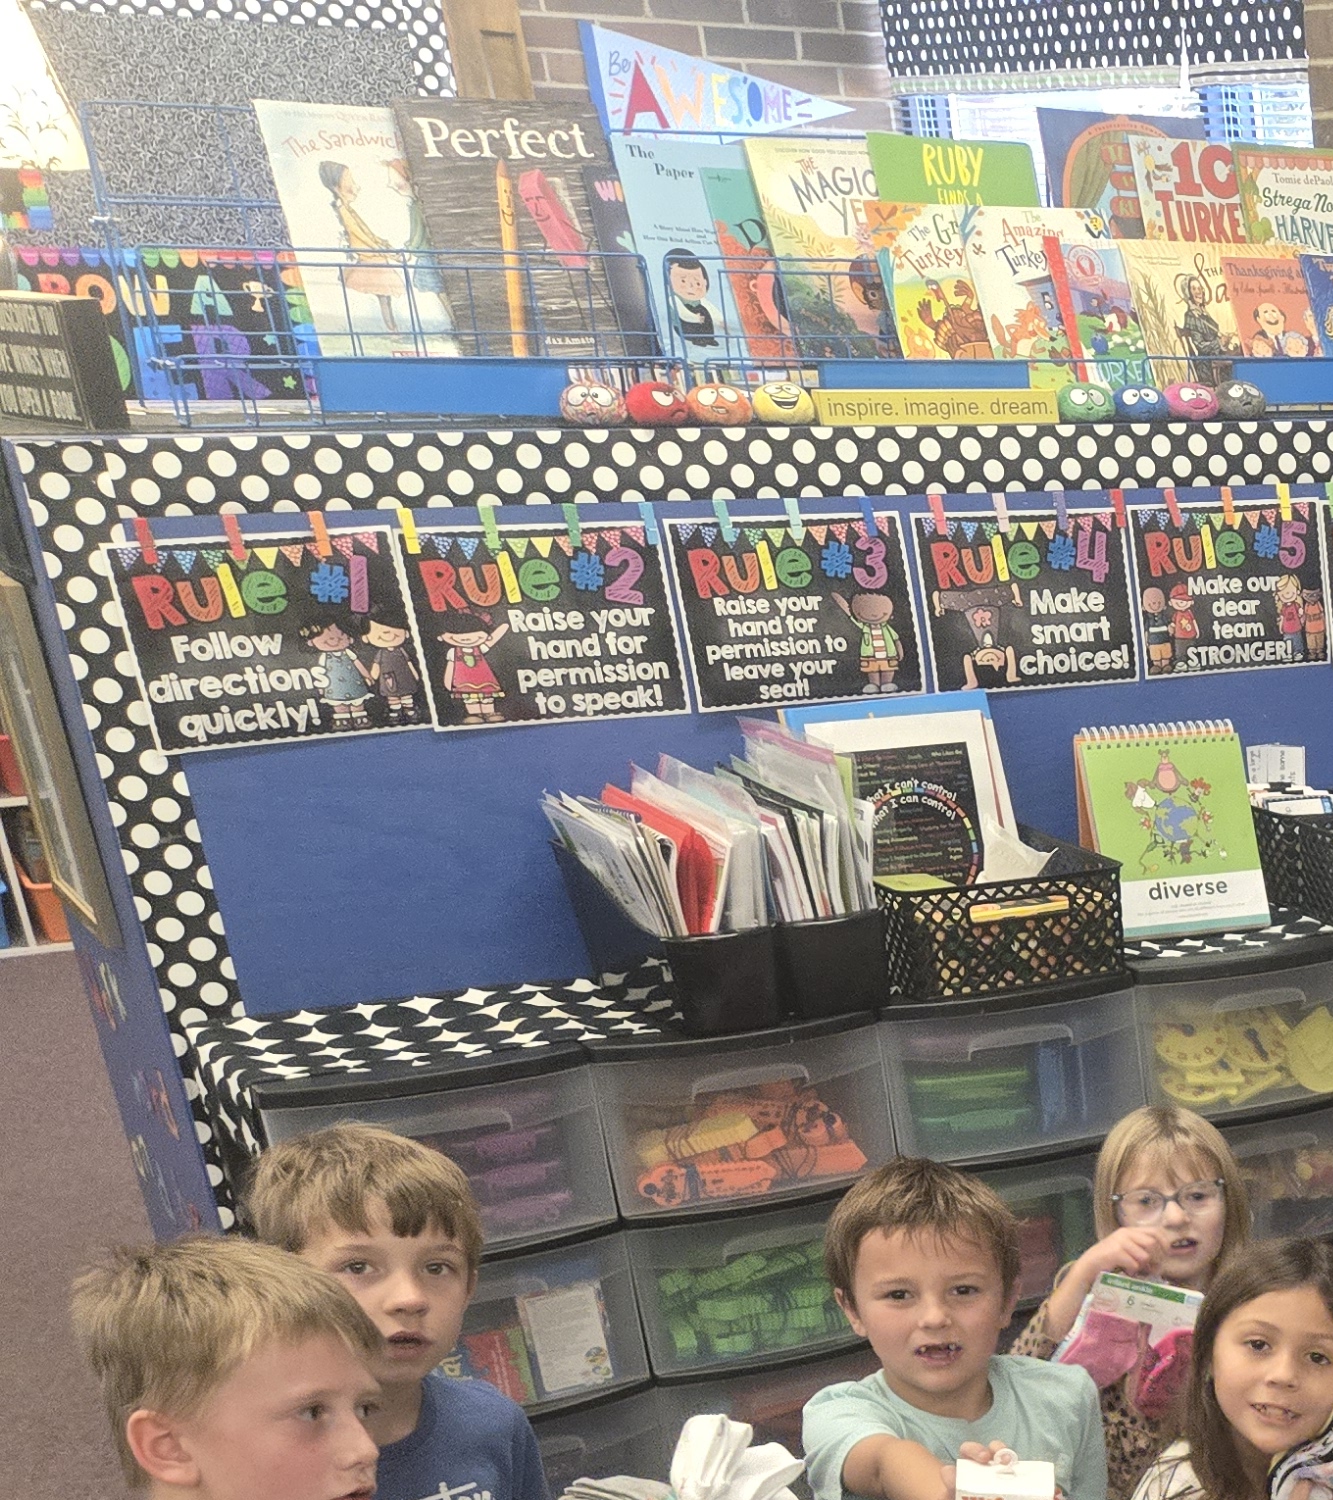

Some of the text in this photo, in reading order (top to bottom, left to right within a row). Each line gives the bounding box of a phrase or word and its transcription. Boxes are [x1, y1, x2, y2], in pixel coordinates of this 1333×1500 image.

[623, 59, 792, 136] AWESOME
[412, 116, 594, 160] Perfect
[625, 143, 654, 159] The
[655, 163, 694, 179] Paper
[923, 142, 984, 187] RUBY
[1272, 173, 1305, 186] Tomie
[1263, 187, 1312, 212] Strega
[827, 398, 1053, 420] inspire. imagine. dream.
[931, 530, 1109, 589] Rule #4
[1144, 520, 1307, 577] Rule #5
[132, 555, 369, 629] Rule #1
[420, 547, 644, 612] Rule #2
[1188, 575, 1279, 596] Make our
[1030, 587, 1105, 615] Make
[1212, 598, 1260, 617] dear
[508, 607, 655, 633] Raise your
[1030, 616, 1110, 644] smart
[1213, 620, 1265, 639] team
[170, 631, 282, 663] Follow
[528, 631, 648, 660] hand for
[1020, 644, 1130, 675] choices!
[1187, 640, 1292, 667] STRONGER!
[148, 665, 330, 703] directions
[518, 658, 670, 693] permission
[535, 684, 664, 716] to speak!
[179, 699, 321, 741] quickly!
[1149, 880, 1228, 901] diverse
